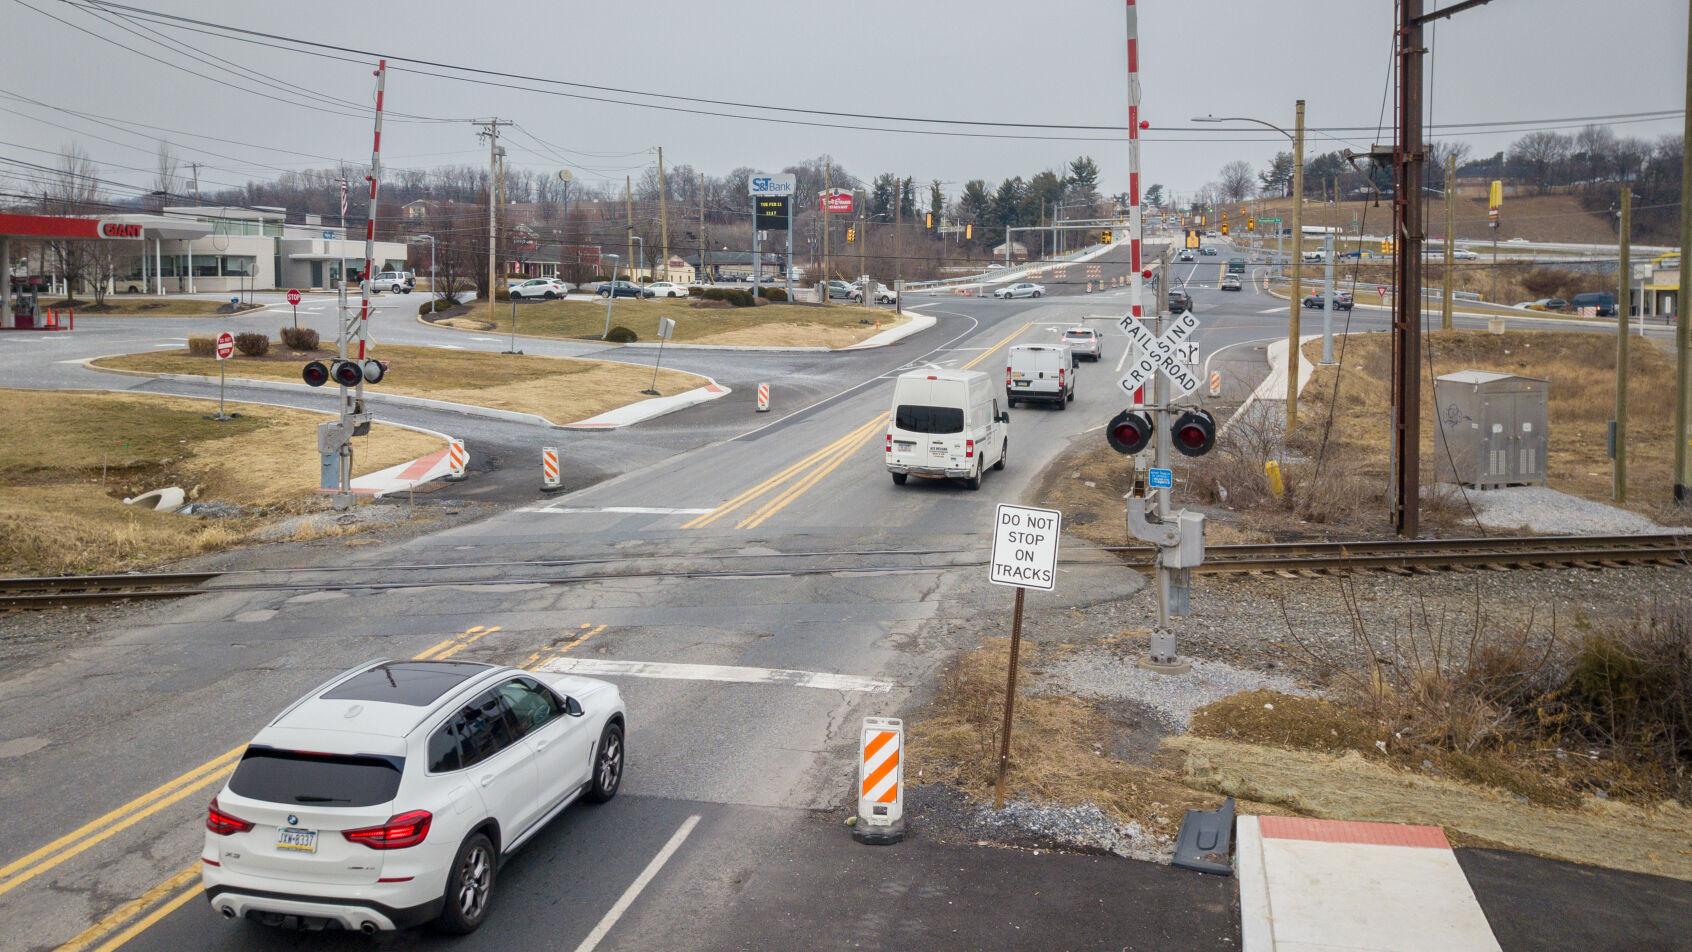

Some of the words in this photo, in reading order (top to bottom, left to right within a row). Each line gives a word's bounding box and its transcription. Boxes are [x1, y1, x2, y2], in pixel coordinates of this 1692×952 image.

[752, 177, 771, 192] S&T
[769, 181, 791, 192] Bank
[103, 223, 143, 238] GIANT
[287, 293, 301, 301] STOP
[1121, 315, 1195, 391] CROSSING
[1001, 513, 1020, 526] DO
[1027, 516, 1054, 530] NOT
[1007, 531, 1045, 546] STOP
[1014, 548, 1034, 563] ON
[995, 563, 1051, 582] TRACKS
